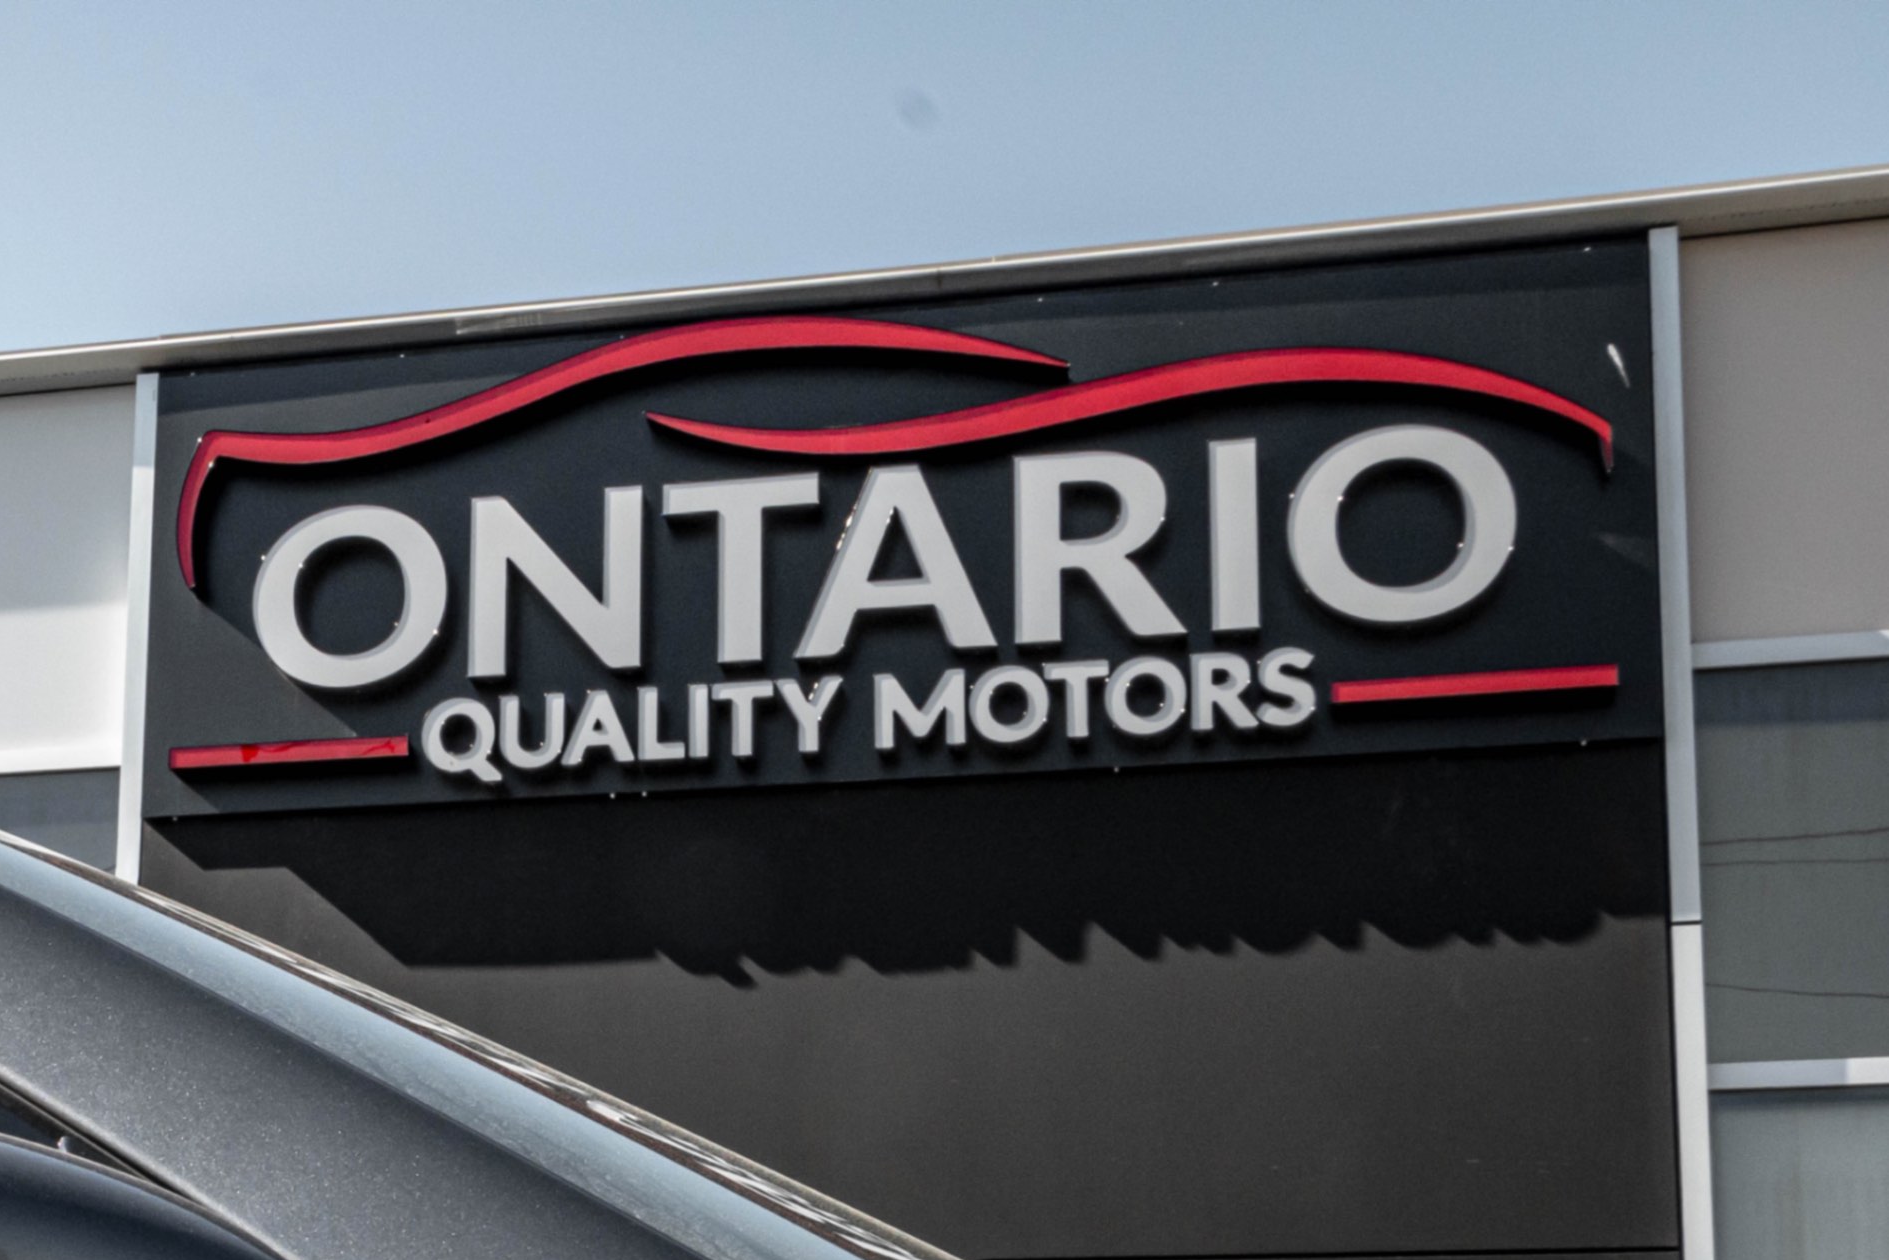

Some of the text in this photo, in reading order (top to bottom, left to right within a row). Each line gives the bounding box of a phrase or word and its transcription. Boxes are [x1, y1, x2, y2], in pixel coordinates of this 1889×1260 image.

[252, 424, 1518, 689] ONTARIO
[420, 646, 1317, 783] QUALITY MOTORS
